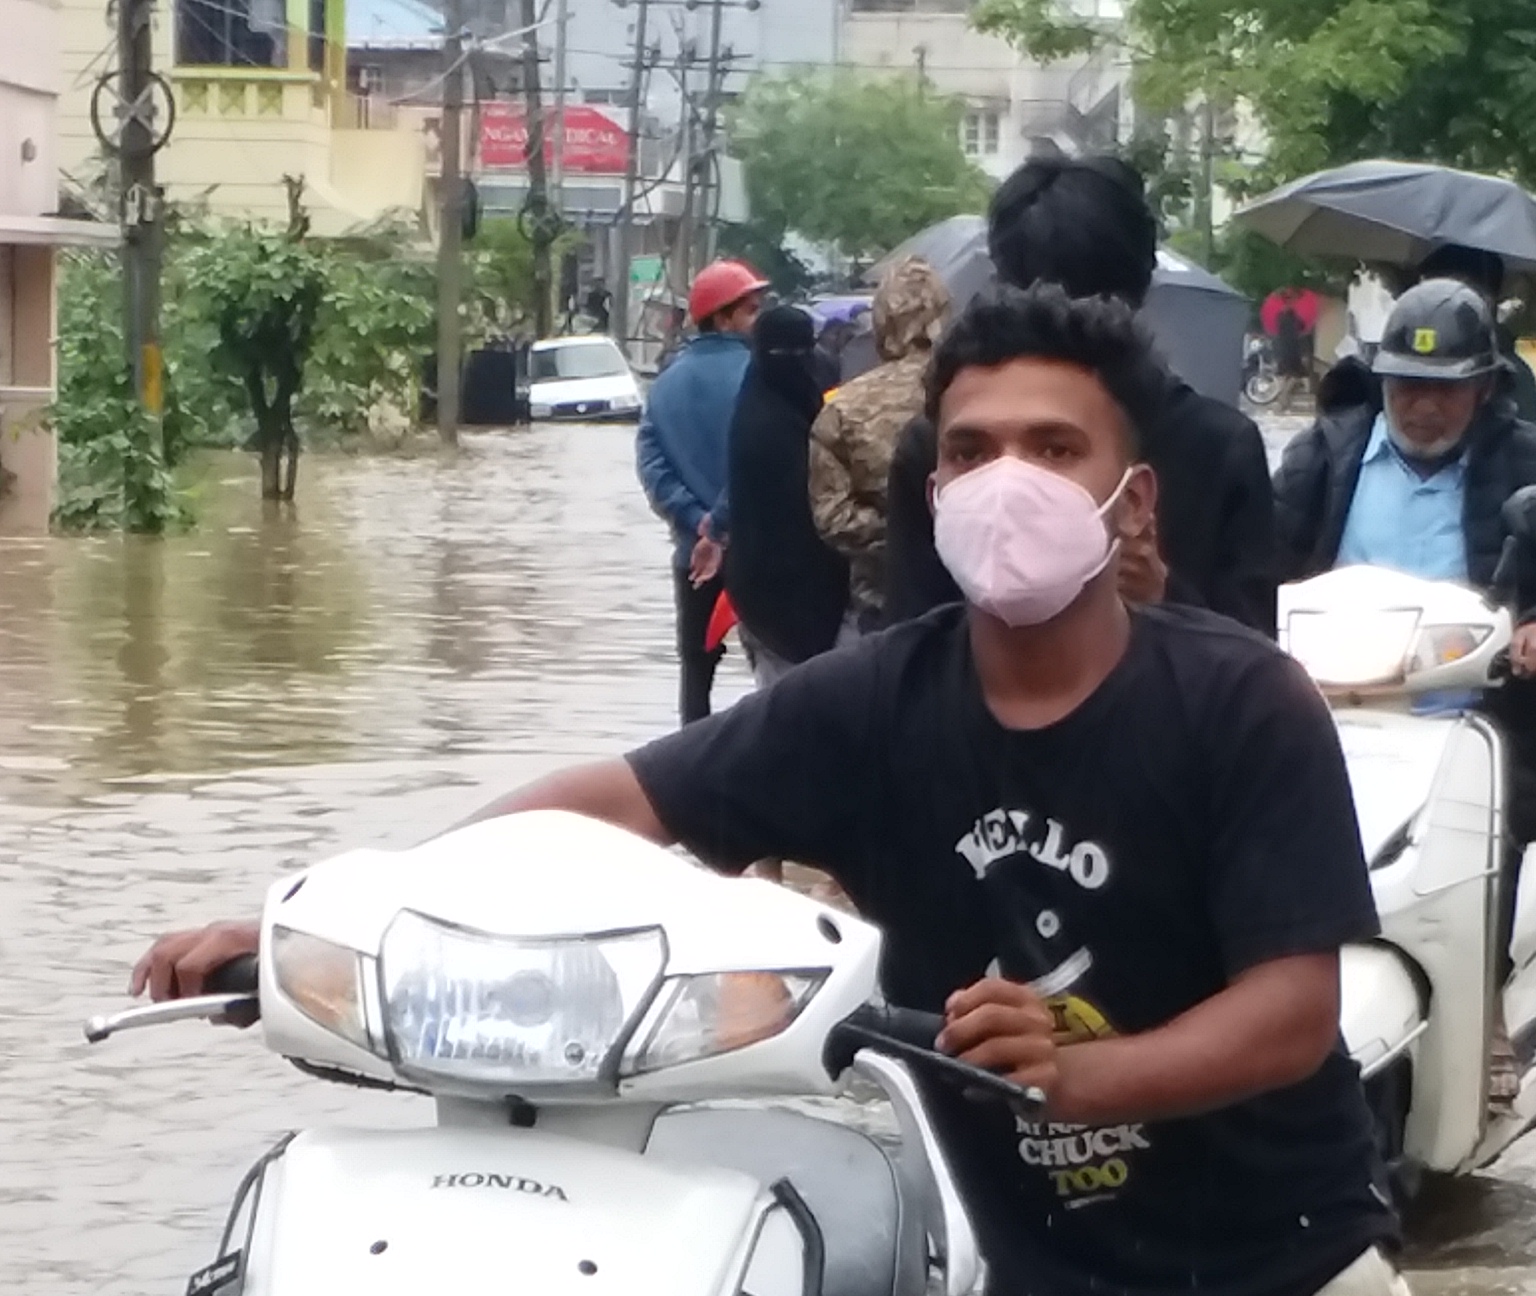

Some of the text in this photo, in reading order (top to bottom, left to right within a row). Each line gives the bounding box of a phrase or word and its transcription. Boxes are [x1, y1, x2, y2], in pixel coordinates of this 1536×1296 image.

[1018, 1124, 1151, 1166] CHUCK
[431, 1172, 570, 1203] HONDA
[1049, 1158, 1128, 1195] TOO
